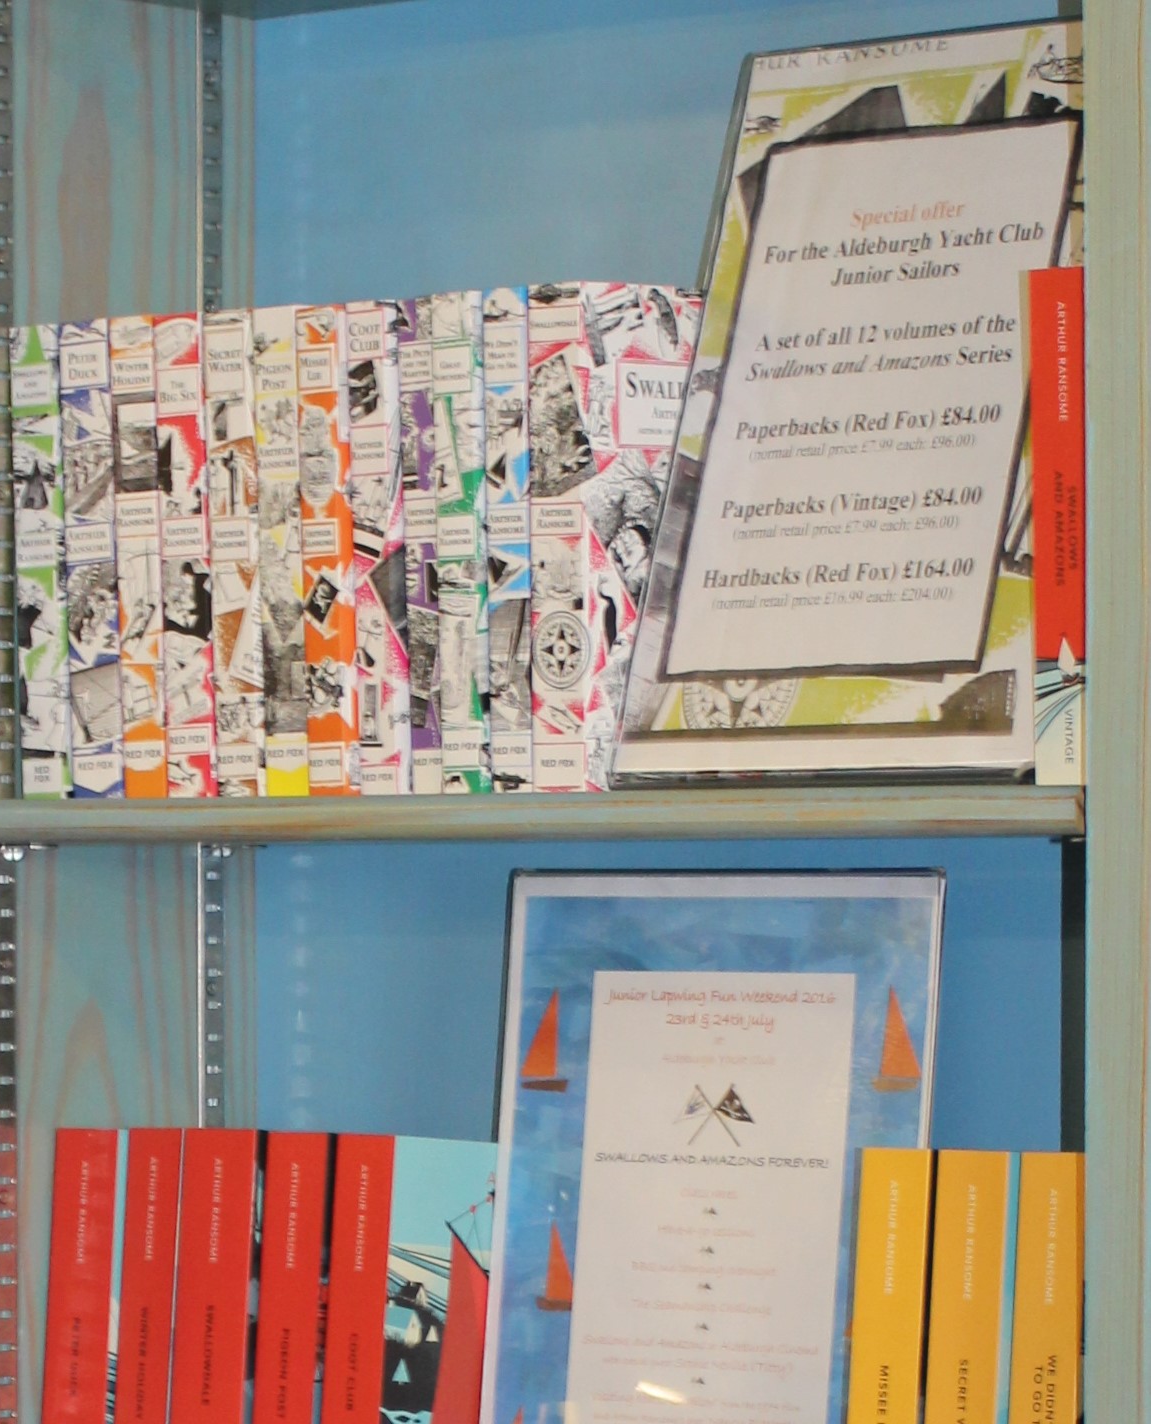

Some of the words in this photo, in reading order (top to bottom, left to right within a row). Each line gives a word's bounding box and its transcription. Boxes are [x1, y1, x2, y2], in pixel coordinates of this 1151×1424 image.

[851, 203, 916, 230] Special
[921, 201, 965, 223] offer
[764, 245, 796, 264] For
[801, 239, 828, 260] the
[834, 232, 932, 259] Aldeburgh
[938, 227, 994, 250] Yacht
[999, 221, 1044, 243] Club
[831, 265, 892, 288] Junior
[897, 259, 960, 281] Sailors
[349, 322, 380, 336] COOT
[755, 335, 771, 352] A
[775, 331, 799, 351] set
[804, 328, 824, 348] of
[827, 325, 851, 346] all
[857, 324, 877, 344] 12
[883, 318, 956, 341] volumes
[961, 316, 982, 336] of
[985, 314, 1016, 334] the
[1056, 301, 1067, 353] ARTHUR
[68, 353, 97, 365] PETER
[349, 338, 380, 352] CLUB
[68, 369, 97, 380] DUCK
[114, 362, 149, 373] WINTER
[745, 358, 827, 382] Swallows
[831, 355, 864, 376] and
[874, 350, 950, 376] Amazons
[955, 344, 1013, 366] Series
[262, 379, 286, 391] POST
[1057, 357, 1069, 422] RANSOME
[736, 415, 839, 441] Paperbacks
[844, 411, 889, 436] (Red
[894, 407, 937, 432] Fox)
[940, 402, 1001, 426] £84.00
[721, 498, 825, 522] Paperbacks
[830, 491, 918, 516] (Vintage)
[921, 485, 983, 508] £84.00
[702, 567, 801, 590] Hardbacks
[805, 564, 850, 587] (Red
[854, 560, 898, 583] Fox)
[901, 556, 974, 580] £164.00
[1063, 709, 1075, 765] VINTAGE
[604, 989, 647, 1004] Junior
[711, 990, 737, 1001] Fun
[741, 990, 798, 1003] Weekend
[594, 1152, 667, 1164] SWALLOWS
[671, 1155, 696, 1165] AND
[699, 1156, 766, 1168] AMAZONS
[1034, 1365, 1043, 1383] TO
[1047, 1354, 1057, 1377] WE
[878, 1365, 890, 1416] MISSEE
[958, 1358, 969, 1414] SECRET
[1033, 1391, 1042, 1414] GO
